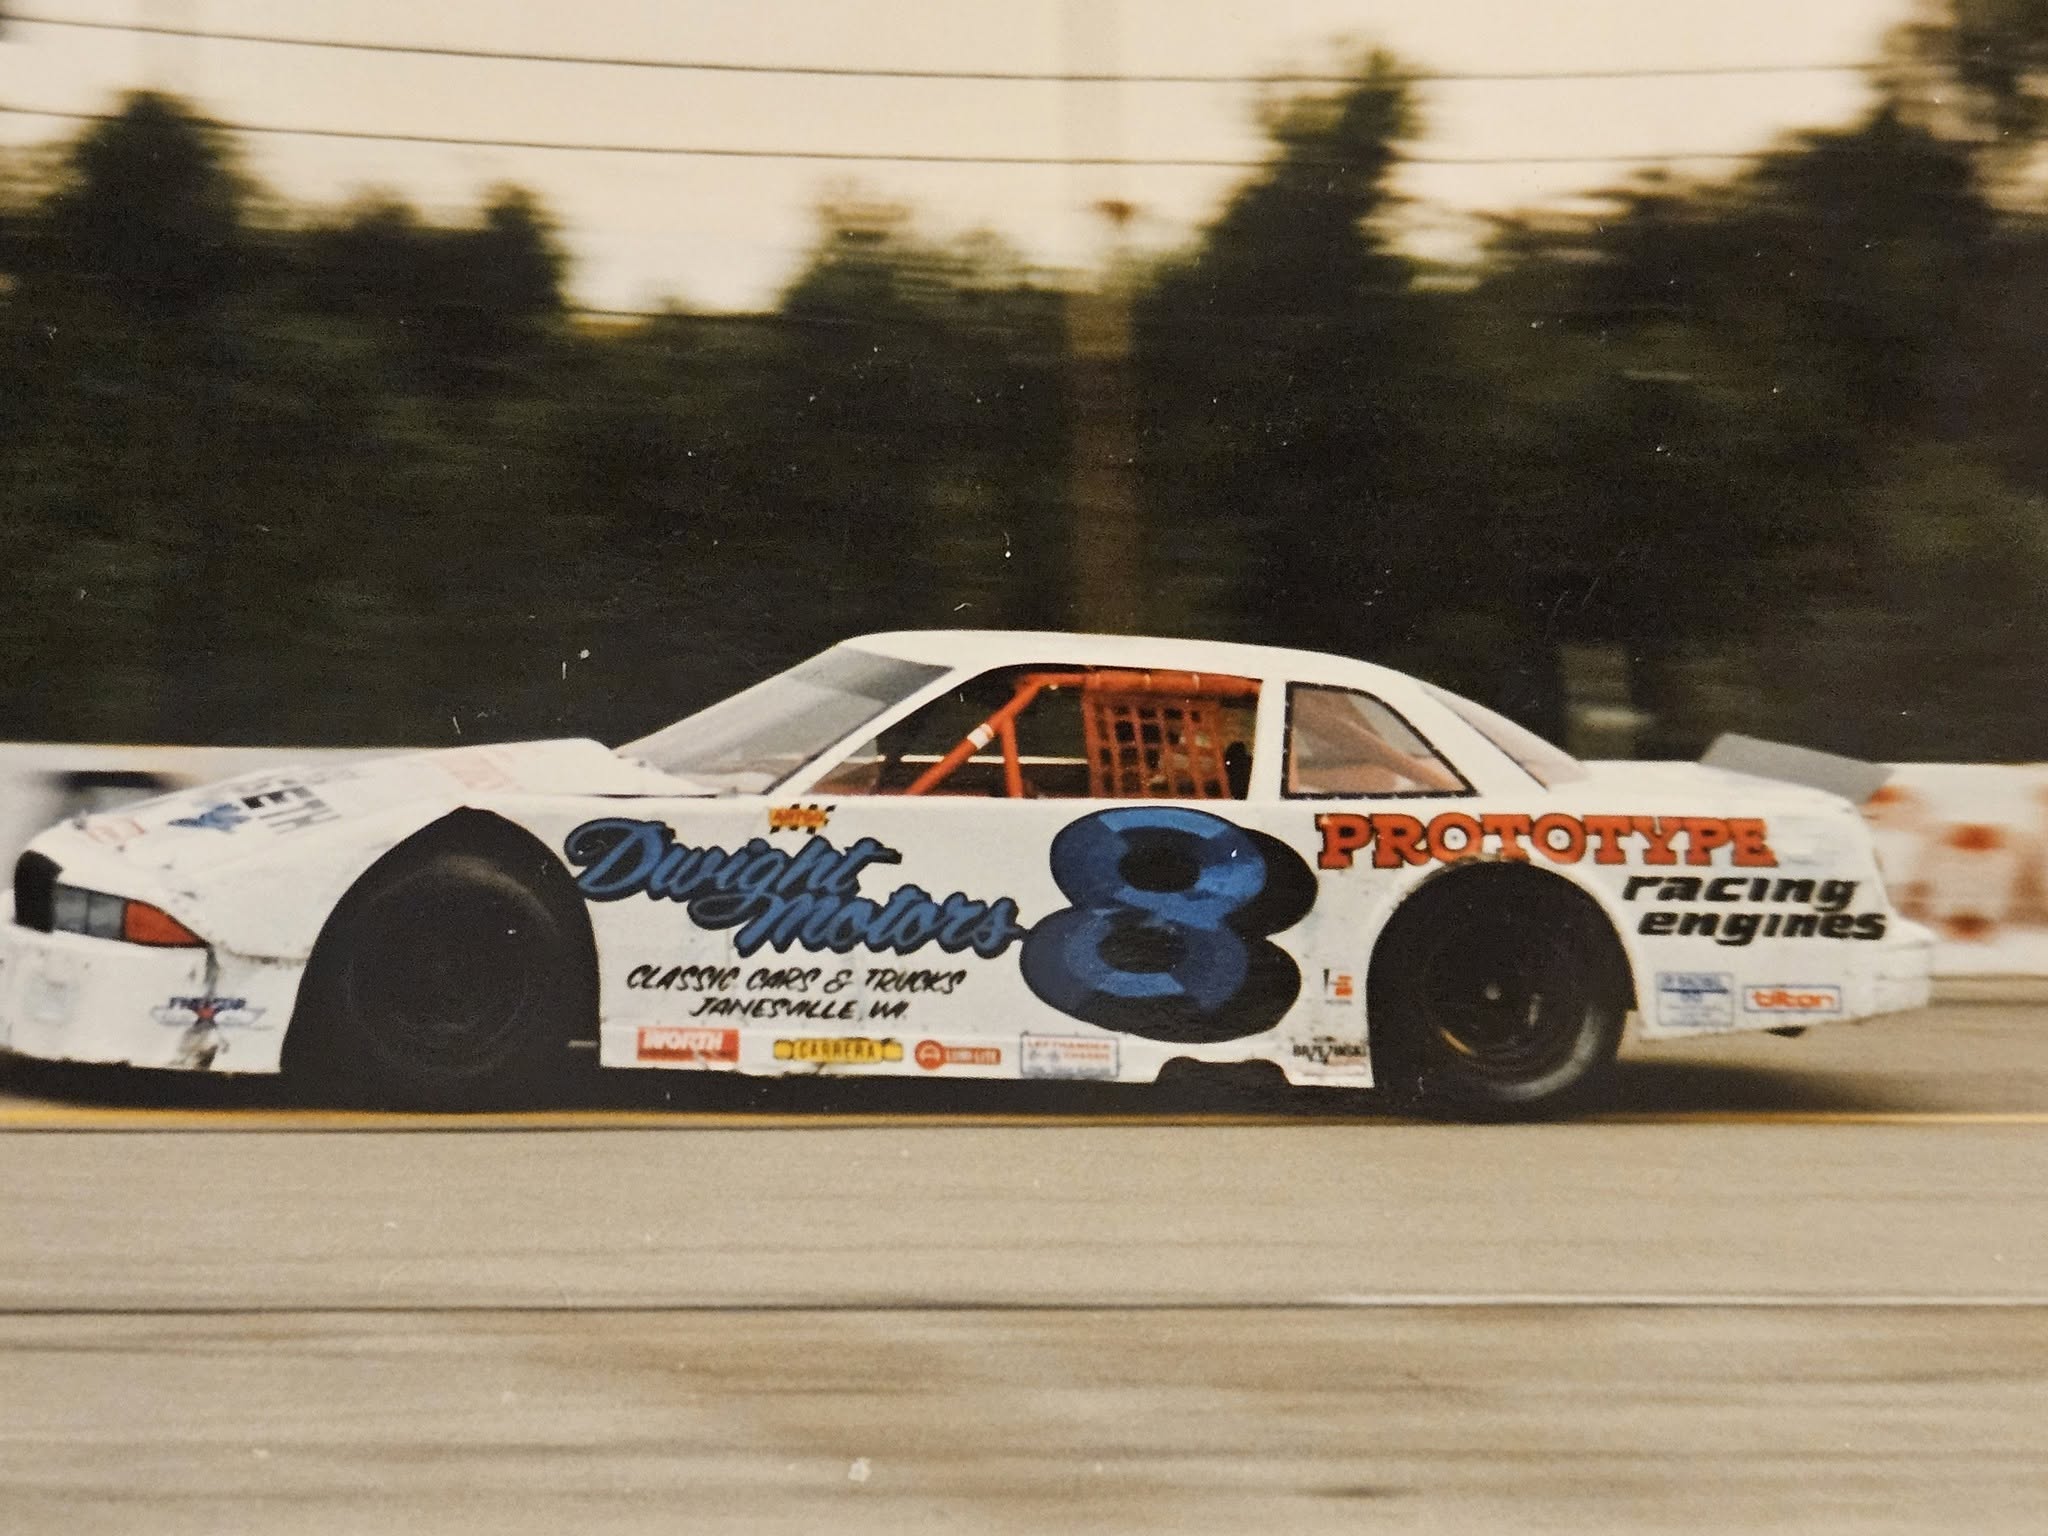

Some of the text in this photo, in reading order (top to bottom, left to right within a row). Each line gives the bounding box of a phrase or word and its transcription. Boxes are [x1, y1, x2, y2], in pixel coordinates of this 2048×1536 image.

[1316, 813, 1778, 869] PROTOTYPE
[564, 817, 902, 930] Dwight
[1623, 876, 1857, 911] racing
[734, 883, 1028, 959] Motors
[1020, 806, 1318, 1043] 8
[1637, 910, 1886, 946] engines
[626, 965, 967, 995] CLASSIC CARS & TRUCKS
[799, 1040, 877, 1060] CARRERA
